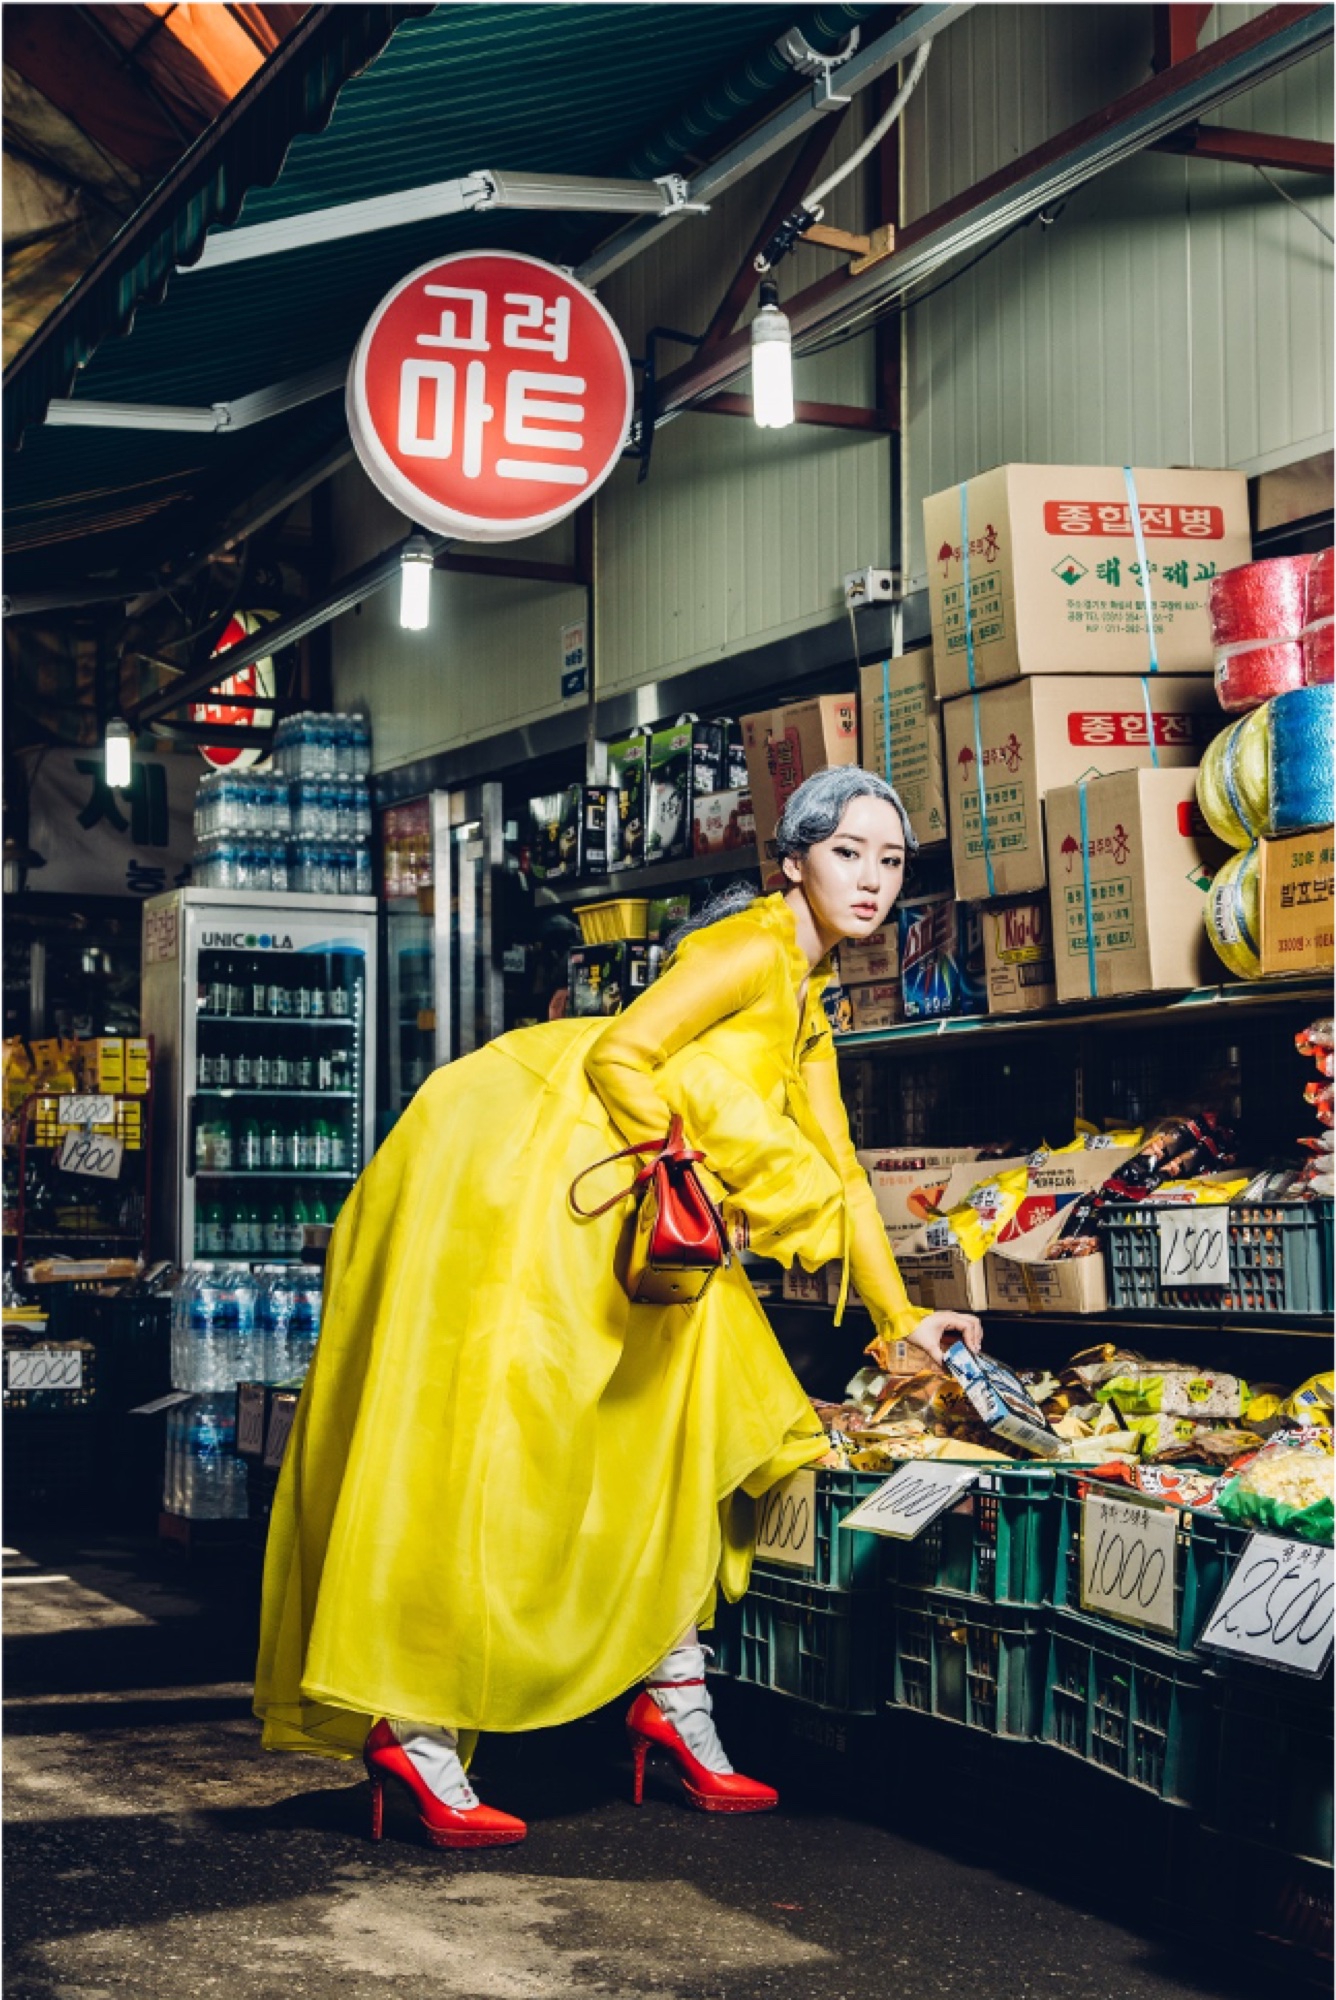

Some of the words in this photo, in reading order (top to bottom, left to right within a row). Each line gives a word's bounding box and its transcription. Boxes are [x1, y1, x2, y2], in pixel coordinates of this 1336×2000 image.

[416, 284, 571, 362] 고려
[397, 358, 589, 486] 마트
[1056, 503, 1213, 537] 종합전병
[1081, 714, 1193, 744] 종합전
[74, 759, 169, 847] 재
